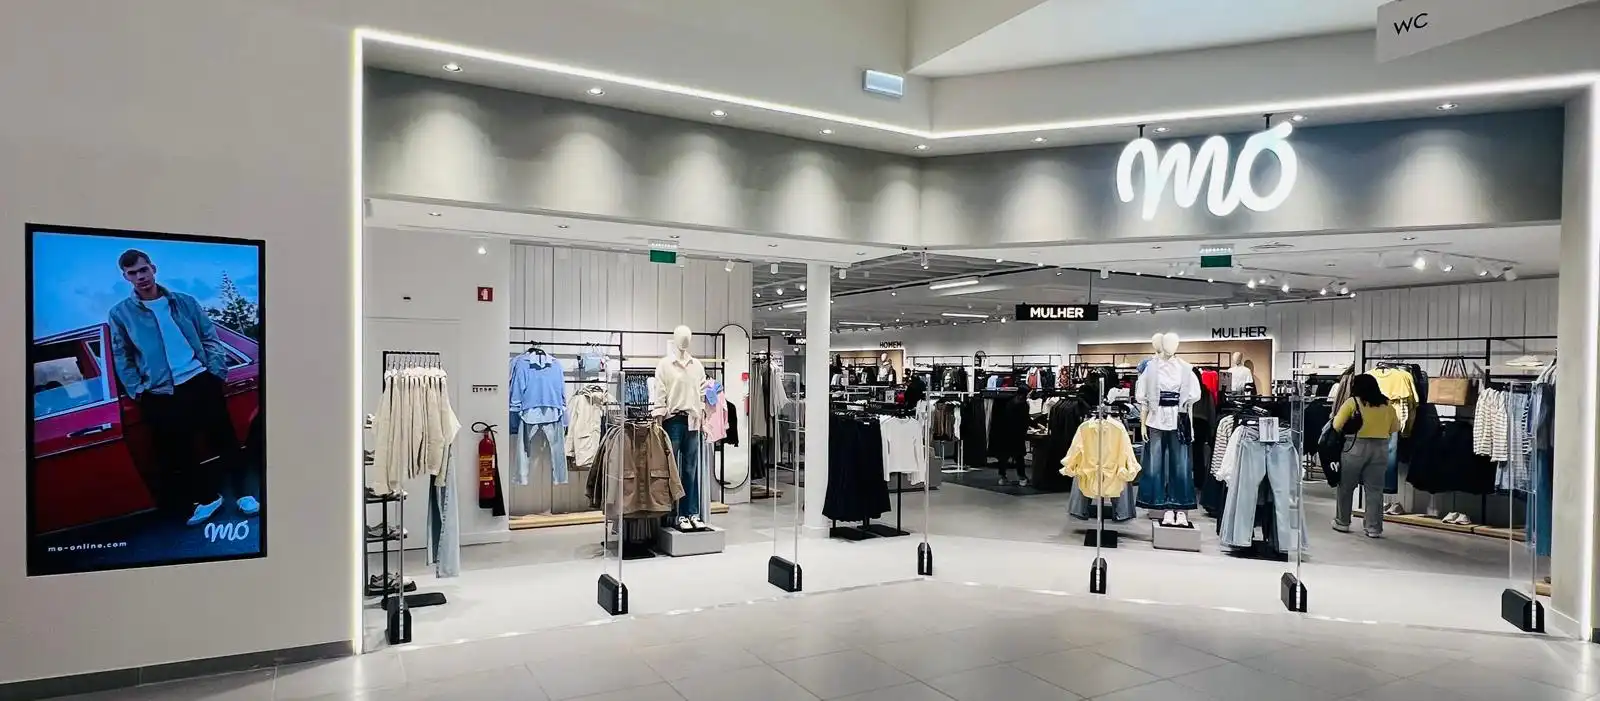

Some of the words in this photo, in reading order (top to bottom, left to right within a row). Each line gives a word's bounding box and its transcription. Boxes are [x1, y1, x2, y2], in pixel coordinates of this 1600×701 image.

[1393, 13, 1429, 36] WC
[1029, 307, 1084, 319] MULHER
[1211, 325, 1267, 339] MULHER
[879, 341, 902, 349] HOMEM
[47, 541, 127, 552] mo-online.com
